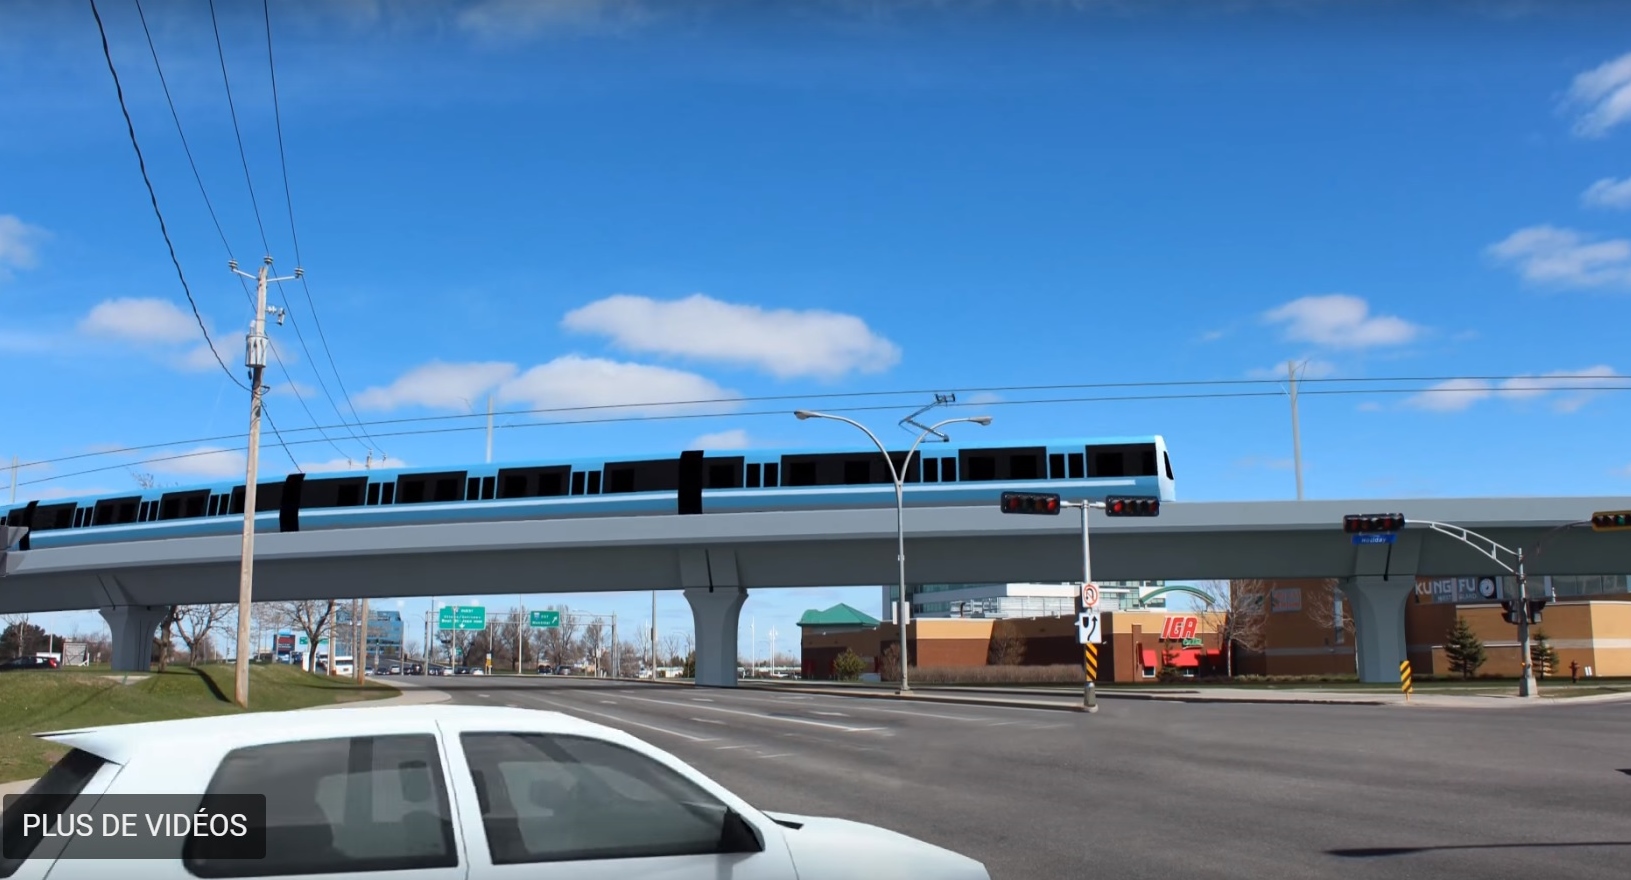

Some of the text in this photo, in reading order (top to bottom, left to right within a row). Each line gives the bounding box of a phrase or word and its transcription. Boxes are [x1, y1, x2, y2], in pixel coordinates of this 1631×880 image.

[1415, 578, 1476, 595] KUNG FU
[1160, 615, 1198, 639] IGA
